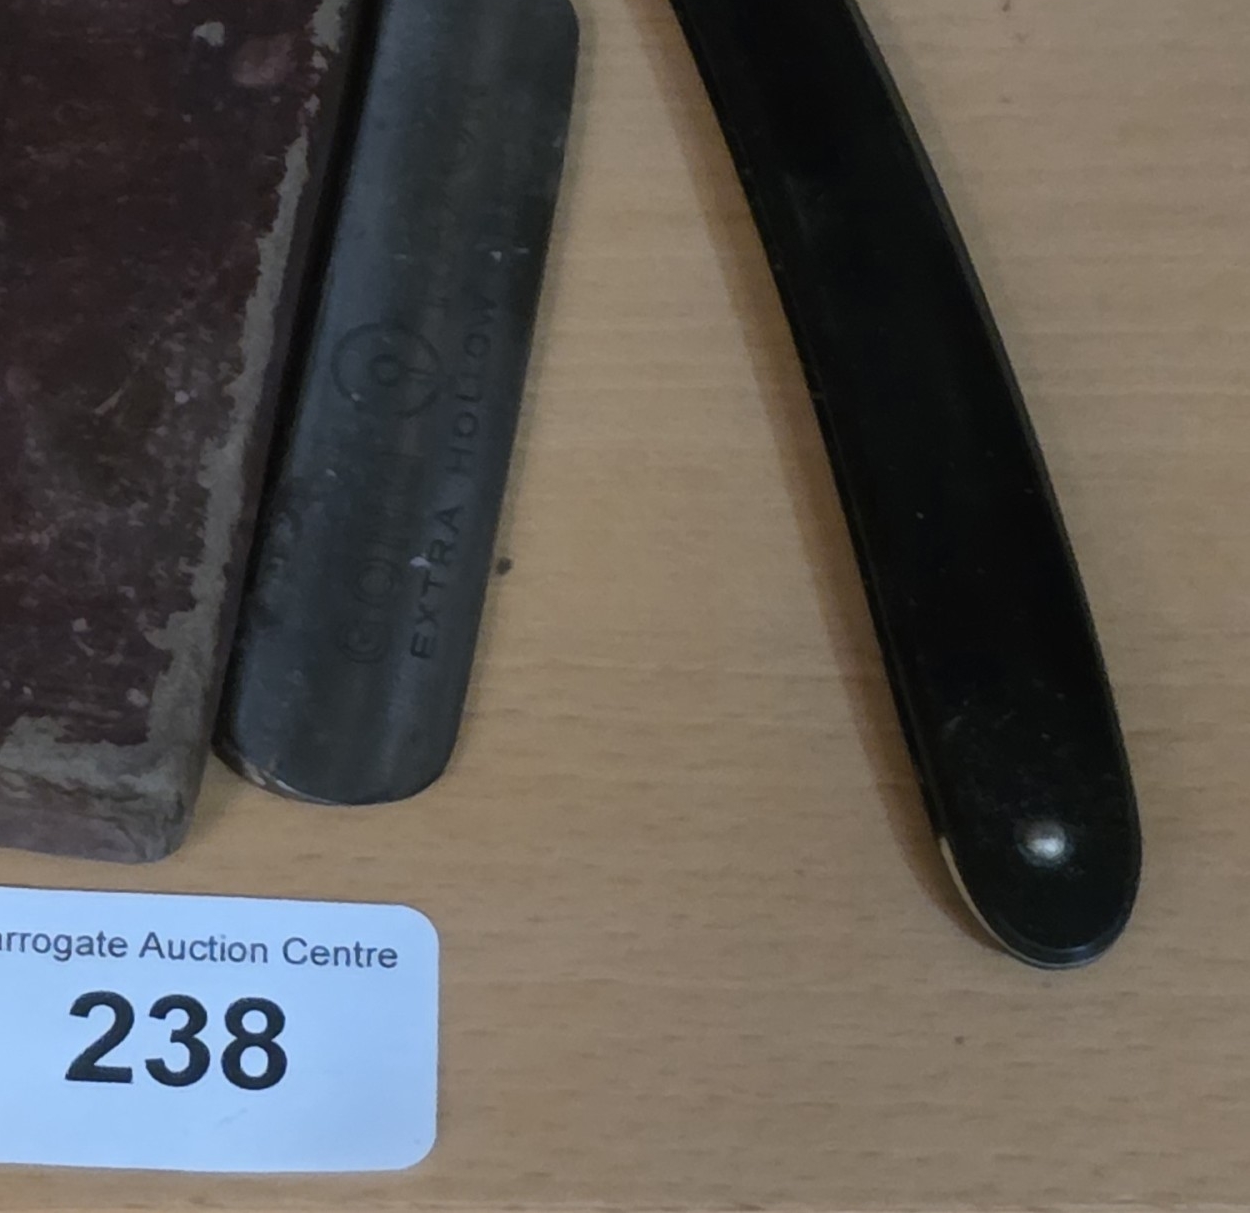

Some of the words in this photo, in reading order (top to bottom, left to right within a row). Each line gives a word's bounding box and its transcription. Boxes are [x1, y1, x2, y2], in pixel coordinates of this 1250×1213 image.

[409, 505, 464, 661] EXTRA
[444, 291, 498, 476] HOLLOW
[139, 931, 268, 964] Auction
[282, 937, 398, 968] Centre
[65, 990, 288, 1090] 238
